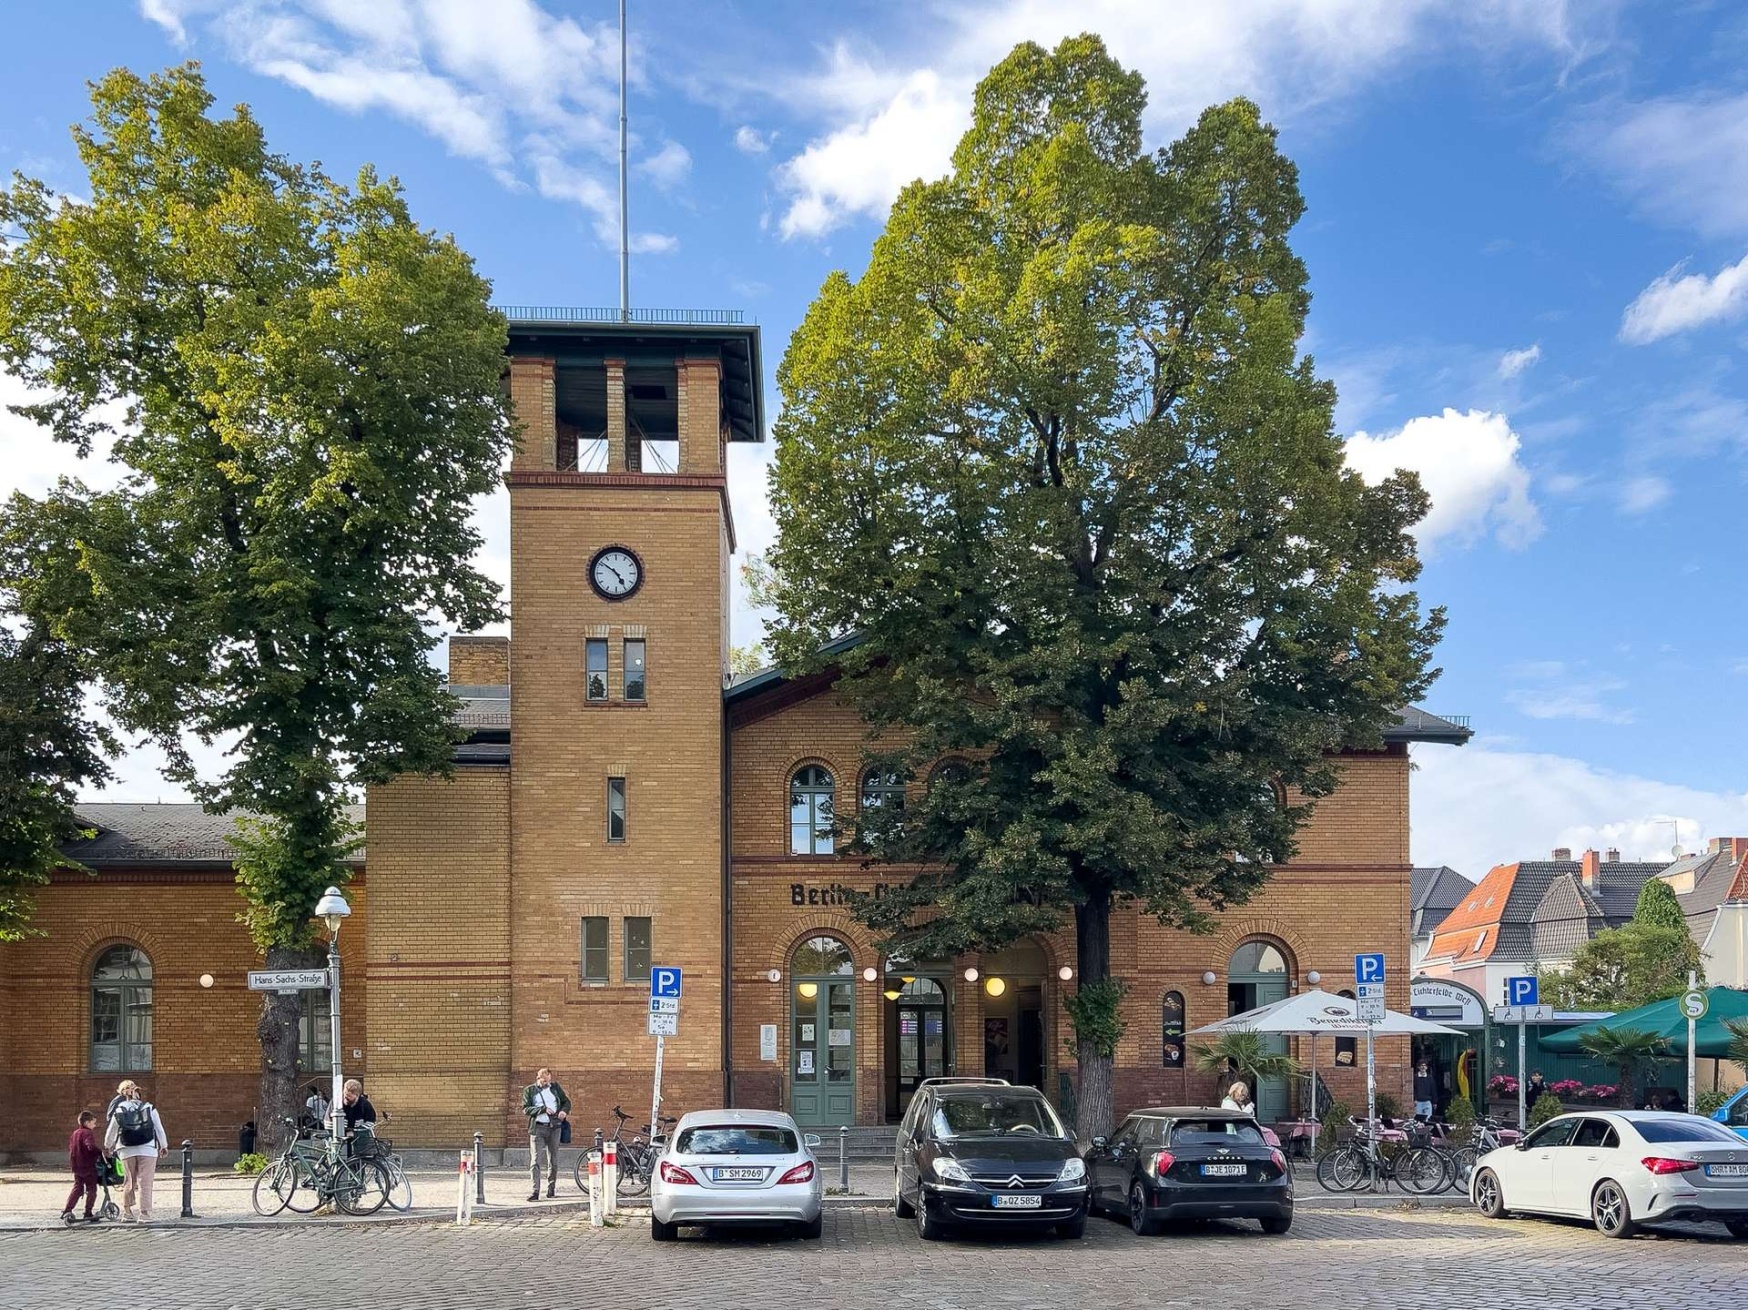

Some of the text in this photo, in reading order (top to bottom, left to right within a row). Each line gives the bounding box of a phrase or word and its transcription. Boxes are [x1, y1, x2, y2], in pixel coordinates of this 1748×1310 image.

[1362, 957, 1378, 981] P
[658, 971, 675, 994] P
[1515, 980, 1532, 1003] P
[1685, 993, 1704, 1017] S
[718, 1169, 724, 1178] B
[741, 1169, 762, 1178] 2969
[997, 1196, 1003, 1205] B
